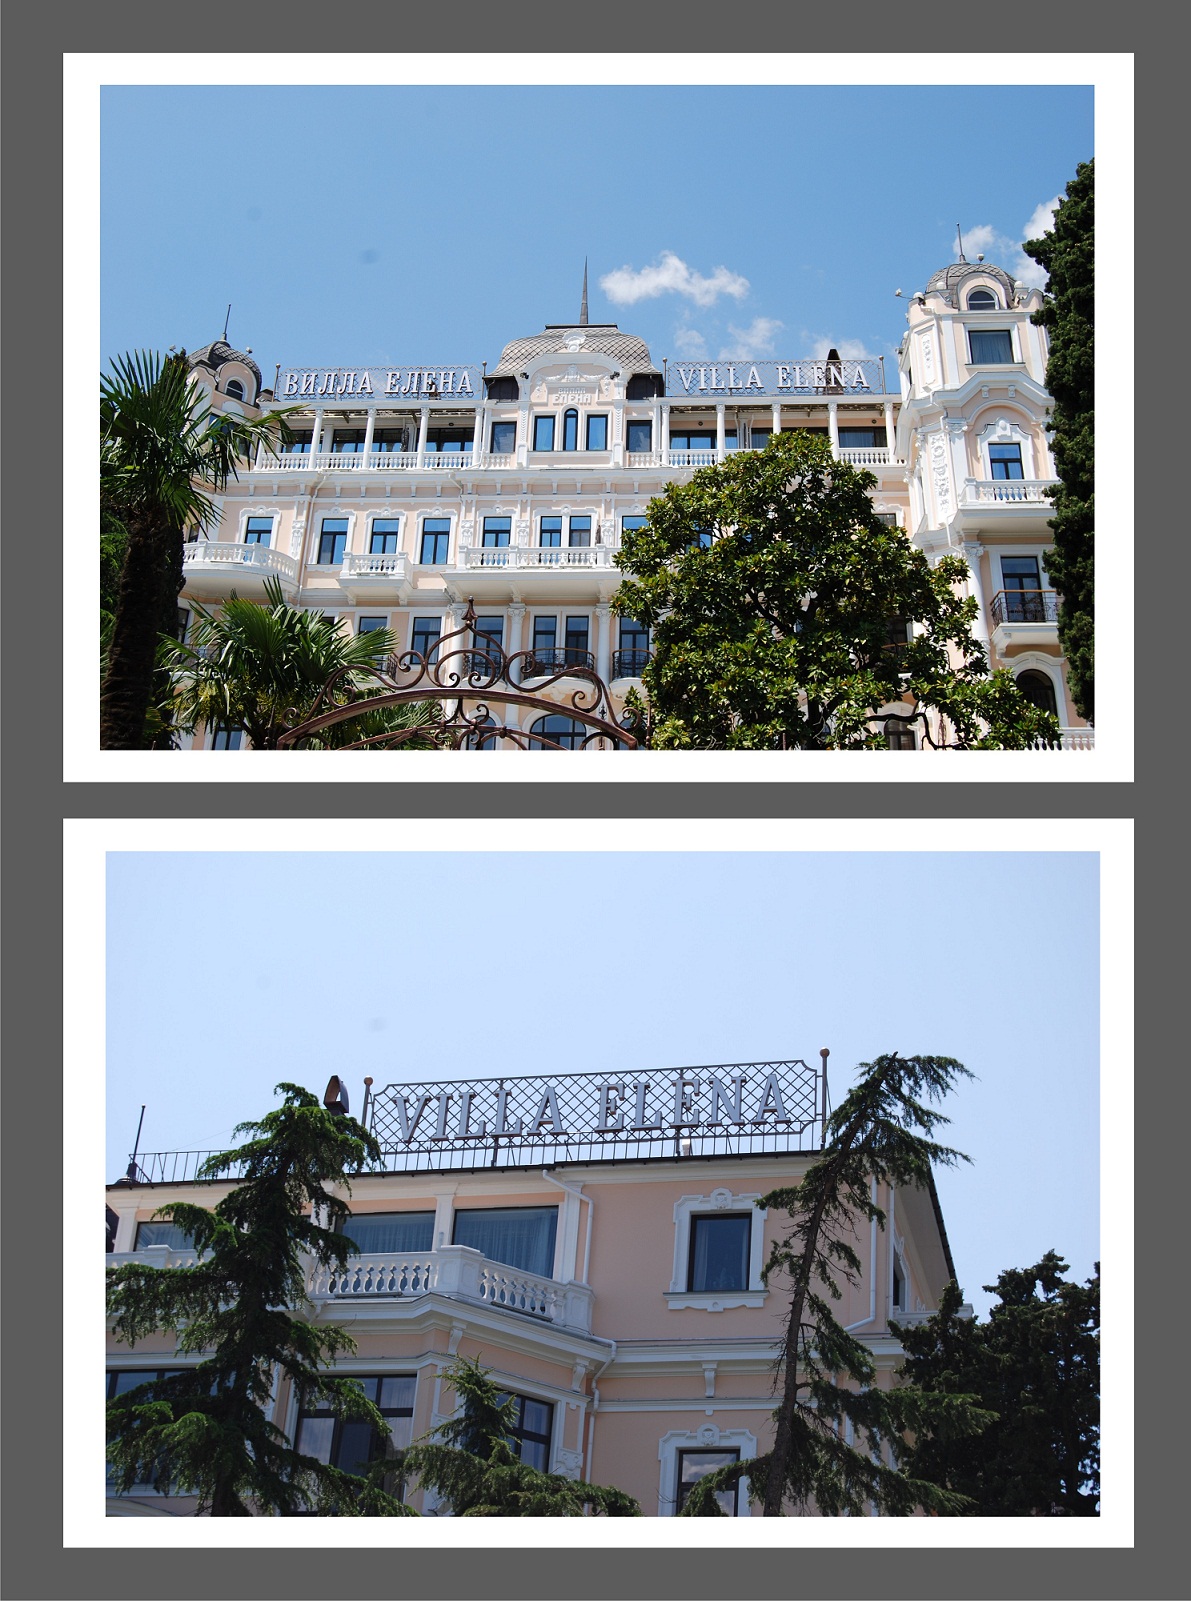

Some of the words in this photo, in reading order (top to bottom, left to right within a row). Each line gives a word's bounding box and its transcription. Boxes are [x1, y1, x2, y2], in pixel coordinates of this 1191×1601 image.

[283, 372, 373, 395] ВИЛЛА
[384, 371, 474, 394] ЕЛЕНА
[677, 366, 765, 391] VILLA
[776, 365, 870, 388] ELENA
[392, 1086, 569, 1144] VILLA
[595, 1073, 791, 1134] ELENA
